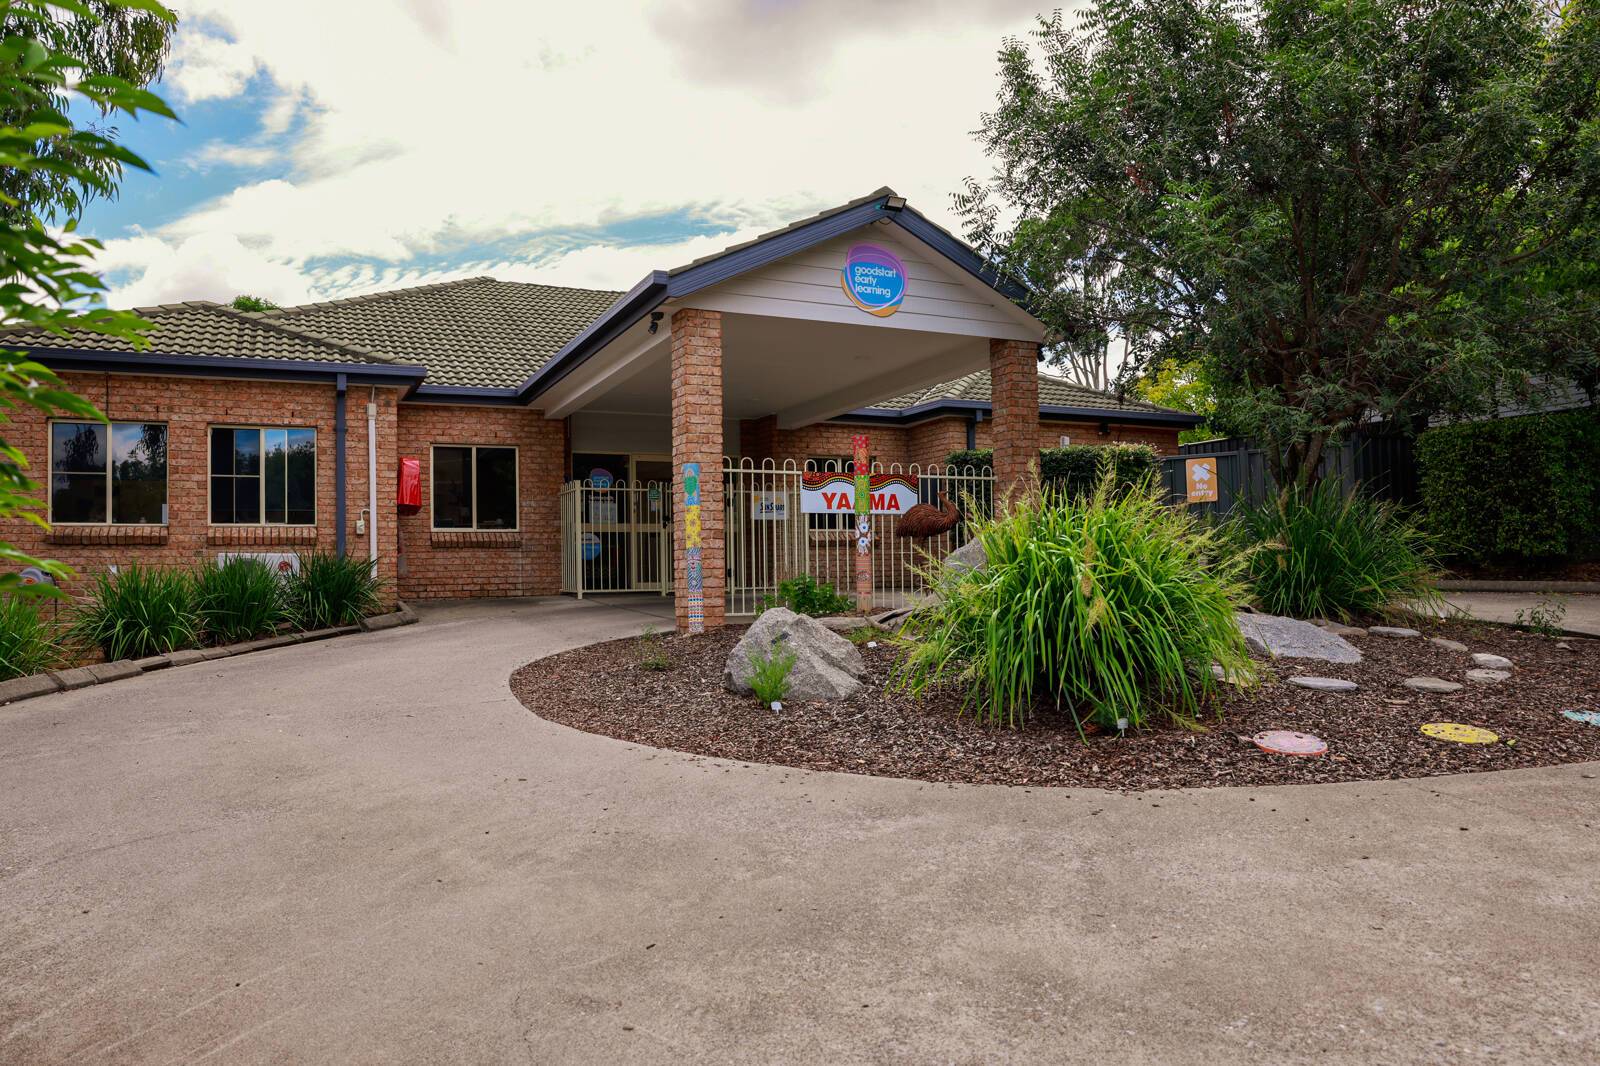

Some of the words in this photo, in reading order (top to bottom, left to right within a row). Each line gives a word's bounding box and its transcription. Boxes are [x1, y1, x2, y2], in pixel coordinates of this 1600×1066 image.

[854, 266, 896, 278] goodstart
[854, 275, 877, 287] early
[855, 283, 891, 298] learning
[1195, 482, 1208, 490] No
[821, 492, 901, 511] YAMA
